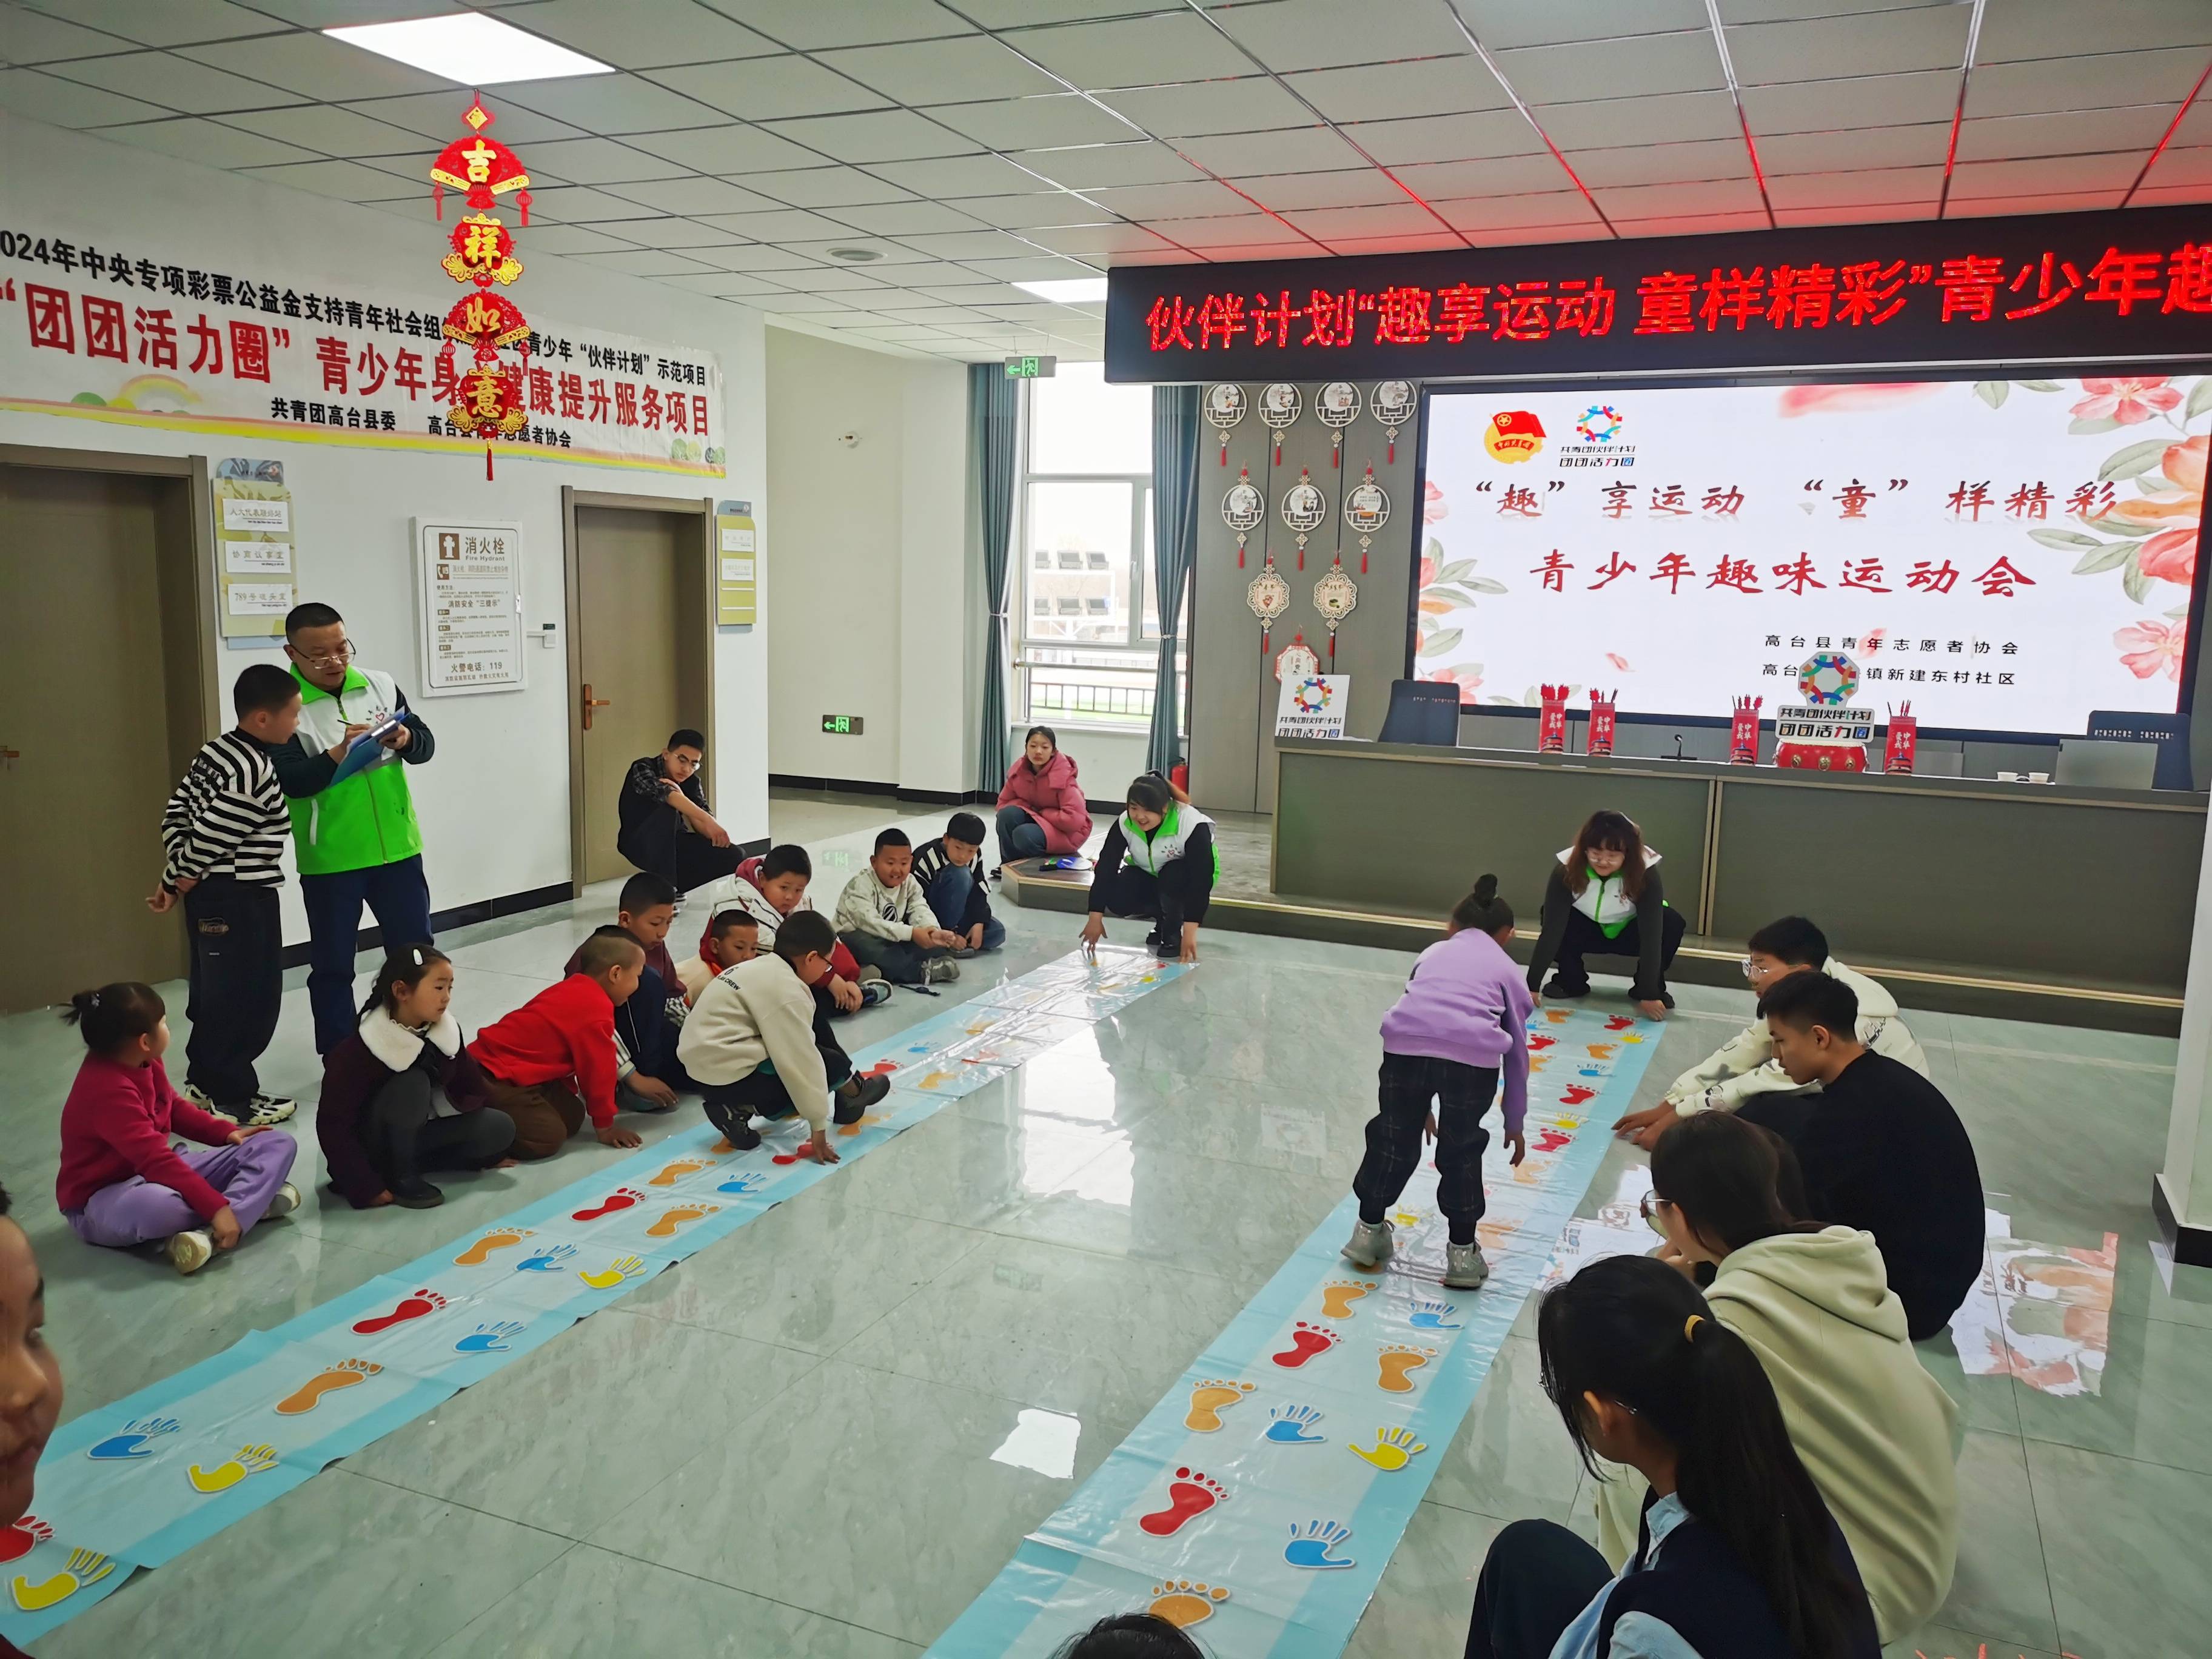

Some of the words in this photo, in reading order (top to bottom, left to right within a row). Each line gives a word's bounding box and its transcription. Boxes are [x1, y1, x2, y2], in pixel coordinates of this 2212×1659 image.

[316, 335, 708, 436] 青少年身健康提升服务项目
[270, 397, 396, 431] 共青团高台县委
[1559, 457, 1635, 468] 团团活力圈
[465, 537, 504, 555] 消火栓
[1529, 548, 2037, 597] 青少年趣味运动会
[1765, 634, 2019, 655] 高台县青年志愿者协会
[1762, 663, 2015, 685] 高台镇新建东村社区
[1279, 716, 1341, 725] 共青团伙伴计划
[1780, 708, 1872, 721] 共青团伙伴计划
[1278, 728, 1340, 739] 团团活力圈
[1779, 723, 1869, 739] 团团活力圈
[725, 978, 741, 991] CREW
